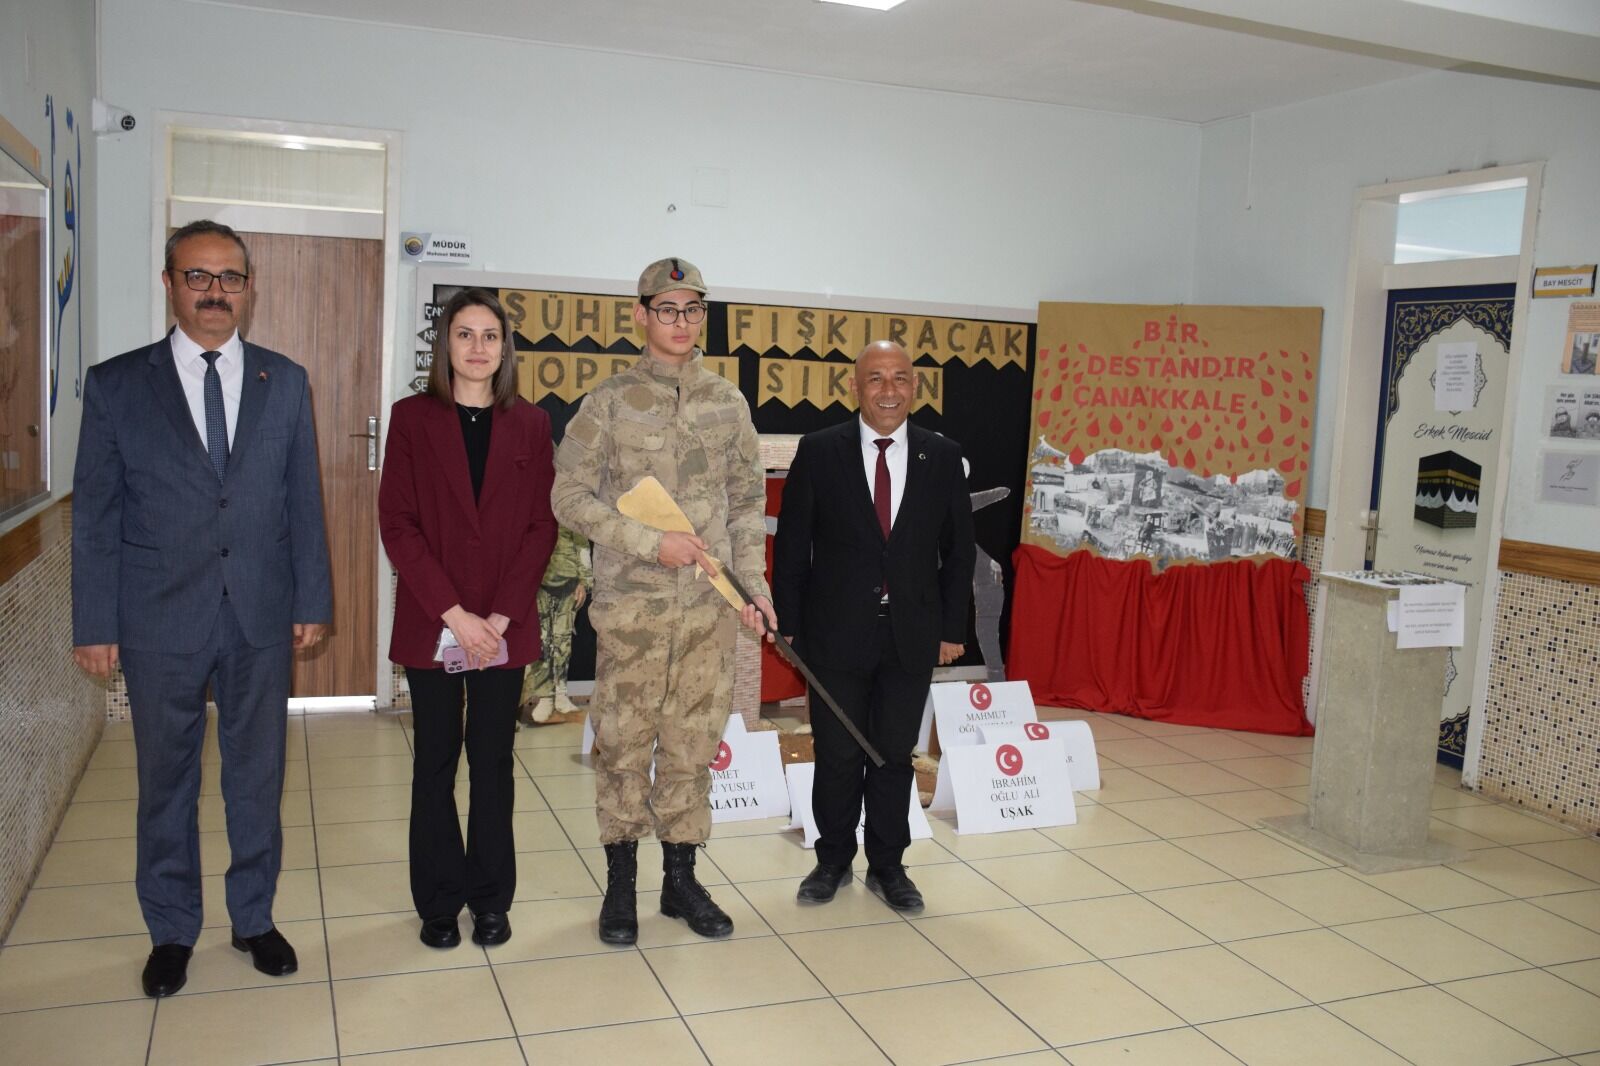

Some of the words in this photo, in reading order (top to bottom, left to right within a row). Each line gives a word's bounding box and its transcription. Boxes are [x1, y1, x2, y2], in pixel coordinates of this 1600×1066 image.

[432, 240, 466, 250] MÜDÜR
[735, 308, 1023, 357] FIŞKIRACAK
[1143, 315, 1199, 343] BİR
[1088, 355, 1256, 380] DESTANDIR
[766, 362, 939, 401] SIKN
[1072, 385, 1247, 414] ÇANAKKALE
[1413, 422, 1446, 439] Erkek
[1447, 424, 1493, 443] Mescid
[965, 710, 1007, 721] MAHMUT
[721, 781, 756, 793] YUSUF
[991, 775, 1037, 789] İBRAHİM
[990, 791, 1018, 802] OĞLU
[1000, 805, 1034, 820] UŞAK
